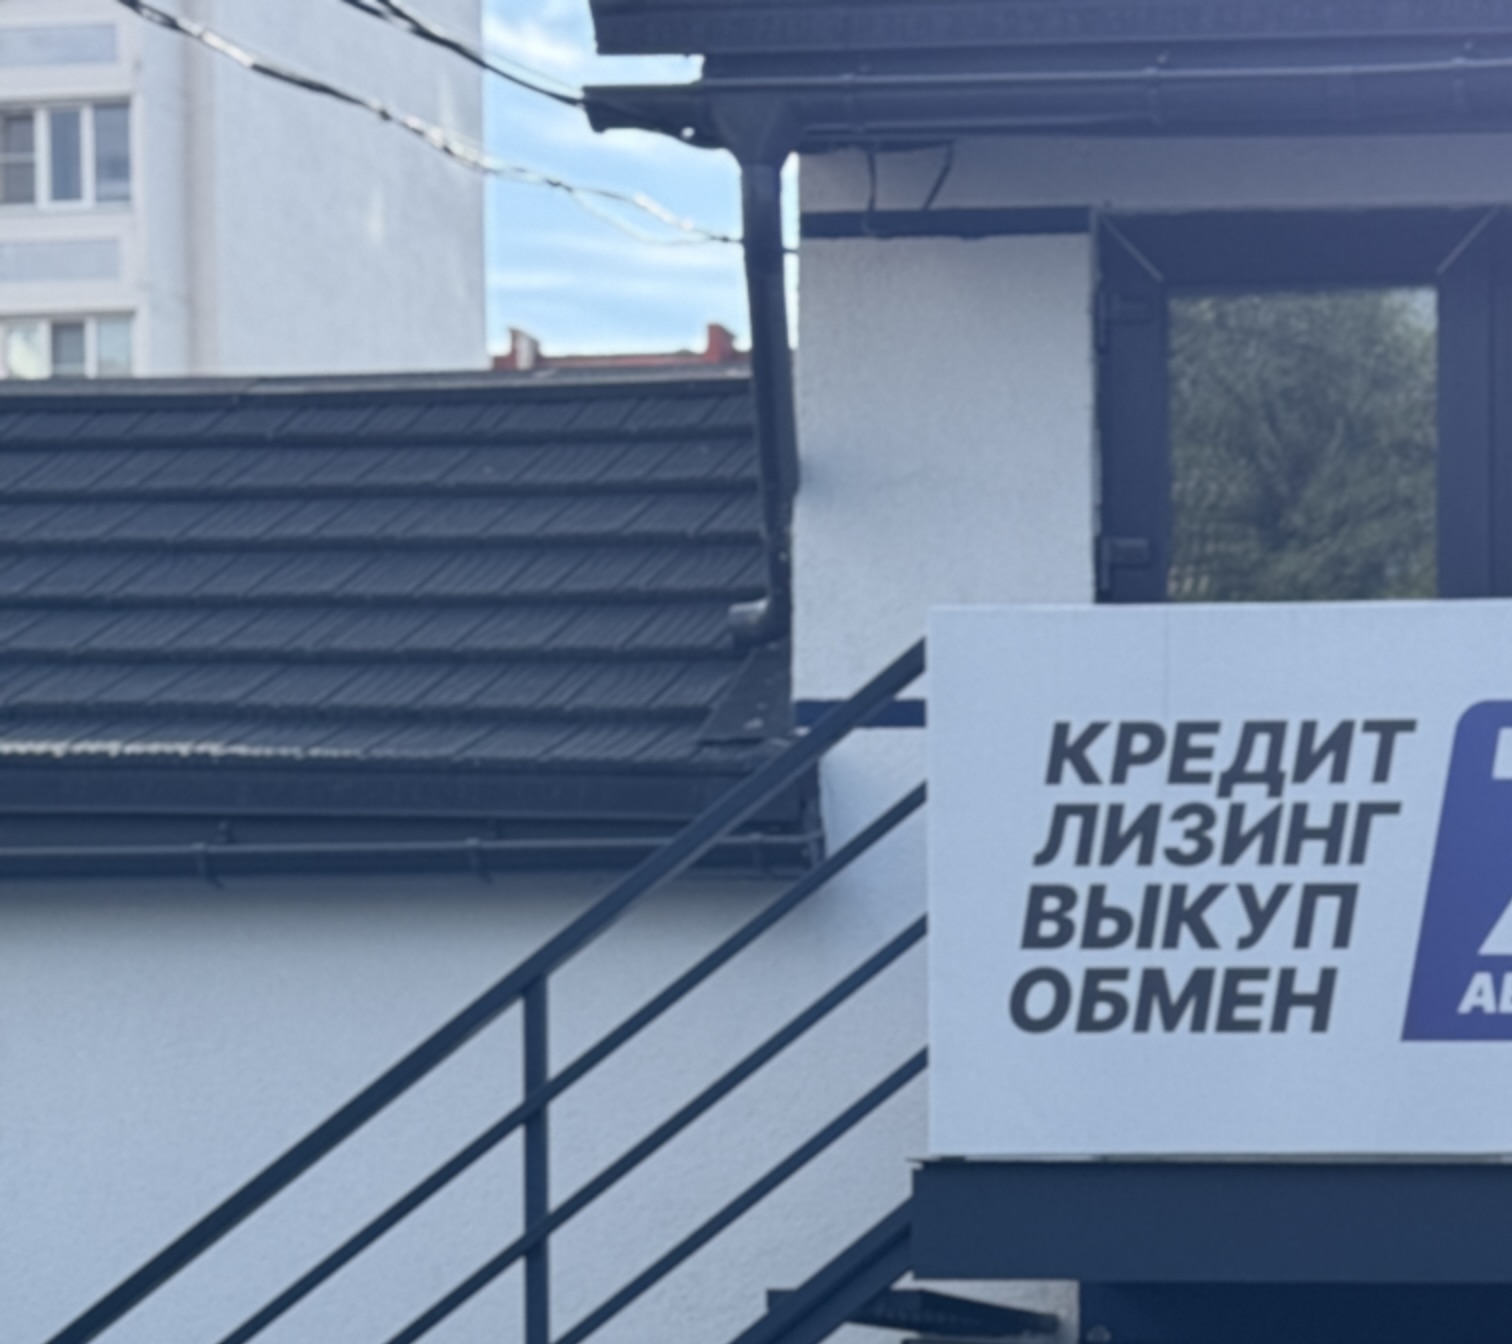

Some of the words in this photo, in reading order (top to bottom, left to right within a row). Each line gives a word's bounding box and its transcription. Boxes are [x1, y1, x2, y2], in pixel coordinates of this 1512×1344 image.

[1045, 719, 1417, 799] КРЕДИТ
[1032, 801, 1402, 867] ЛИЗИНГ
[1020, 882, 1360, 950] ВЫКУП
[1009, 966, 1338, 1034] ОБМЕН
